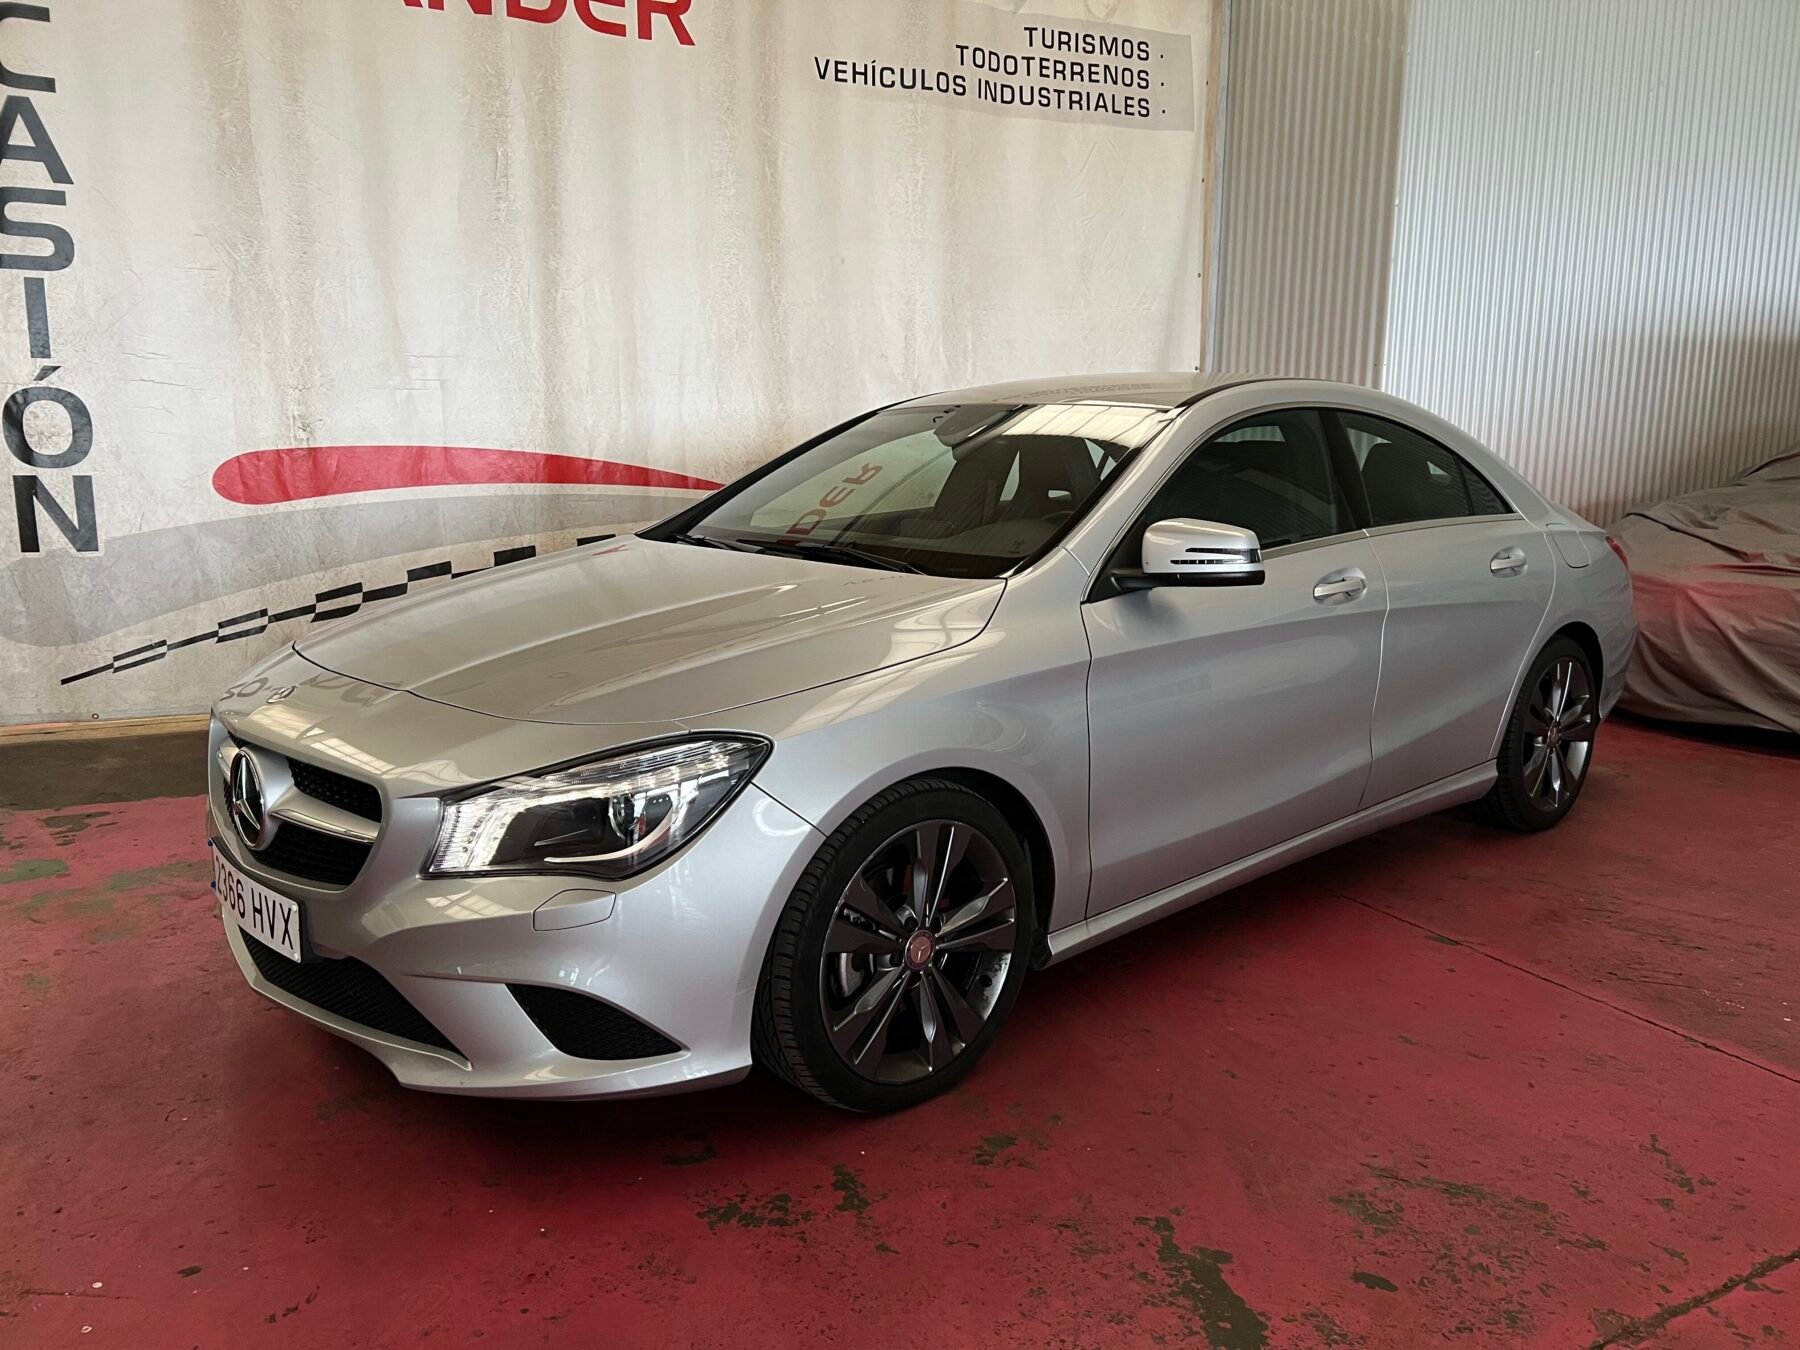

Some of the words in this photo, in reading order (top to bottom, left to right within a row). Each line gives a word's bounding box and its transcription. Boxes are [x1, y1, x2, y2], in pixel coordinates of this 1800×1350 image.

[955, 44, 1150, 90] TODOTERRENOS
[1023, 26, 1150, 62] TURISMOS
[814, 56, 967, 97] VEHÍCULOS
[978, 78, 1150, 118] INDUSTRIALES
[215, 855, 246, 919] 2366
[251, 887, 294, 951] HVX
